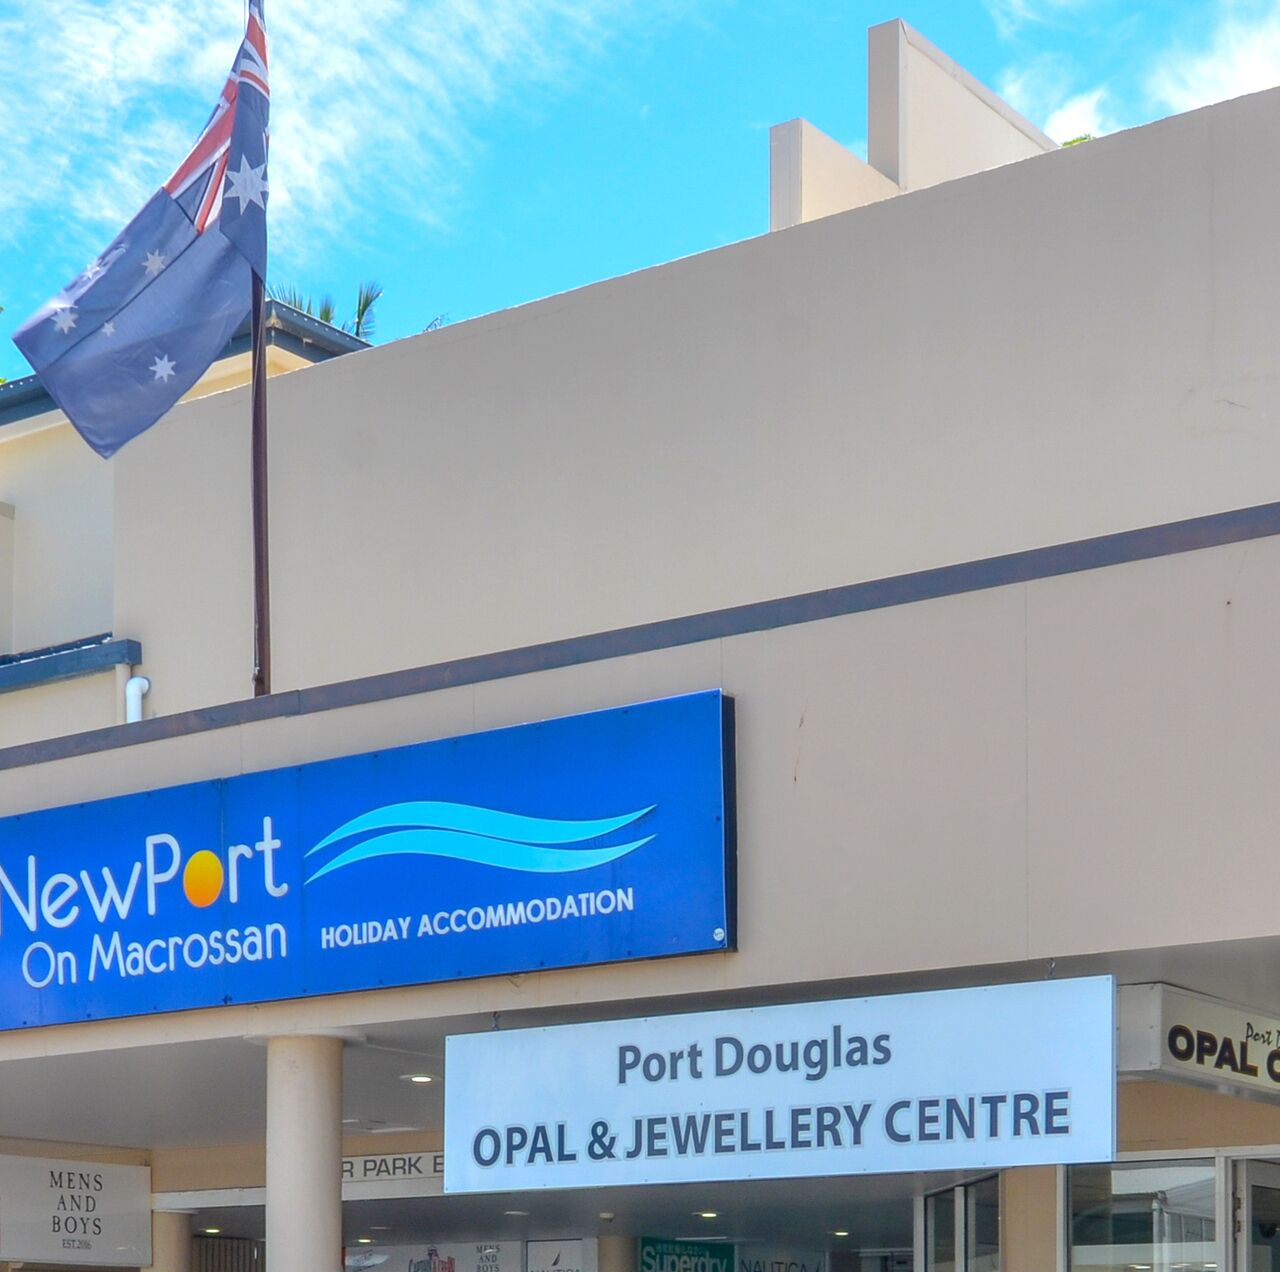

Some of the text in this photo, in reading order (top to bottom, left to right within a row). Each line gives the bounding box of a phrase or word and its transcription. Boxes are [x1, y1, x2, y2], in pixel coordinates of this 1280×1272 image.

[320, 887, 635, 949] HOLIDAY ACCOMMODATION
[21, 922, 287, 988] On Macrossan
[1245, 1022, 1272, 1046] Port
[618, 1024, 892, 1085] Port Douglas
[1168, 1024, 1258, 1078] OPAL
[472, 1090, 1072, 1169] OPAL & JEWELLERY CENTRE
[364, 1157, 423, 1176] PARK
[50, 1170, 103, 1191] MENS
[57, 1194, 96, 1212] AND
[52, 1215, 102, 1235] BOYS
[477, 1265, 500, 1272] BOYS
